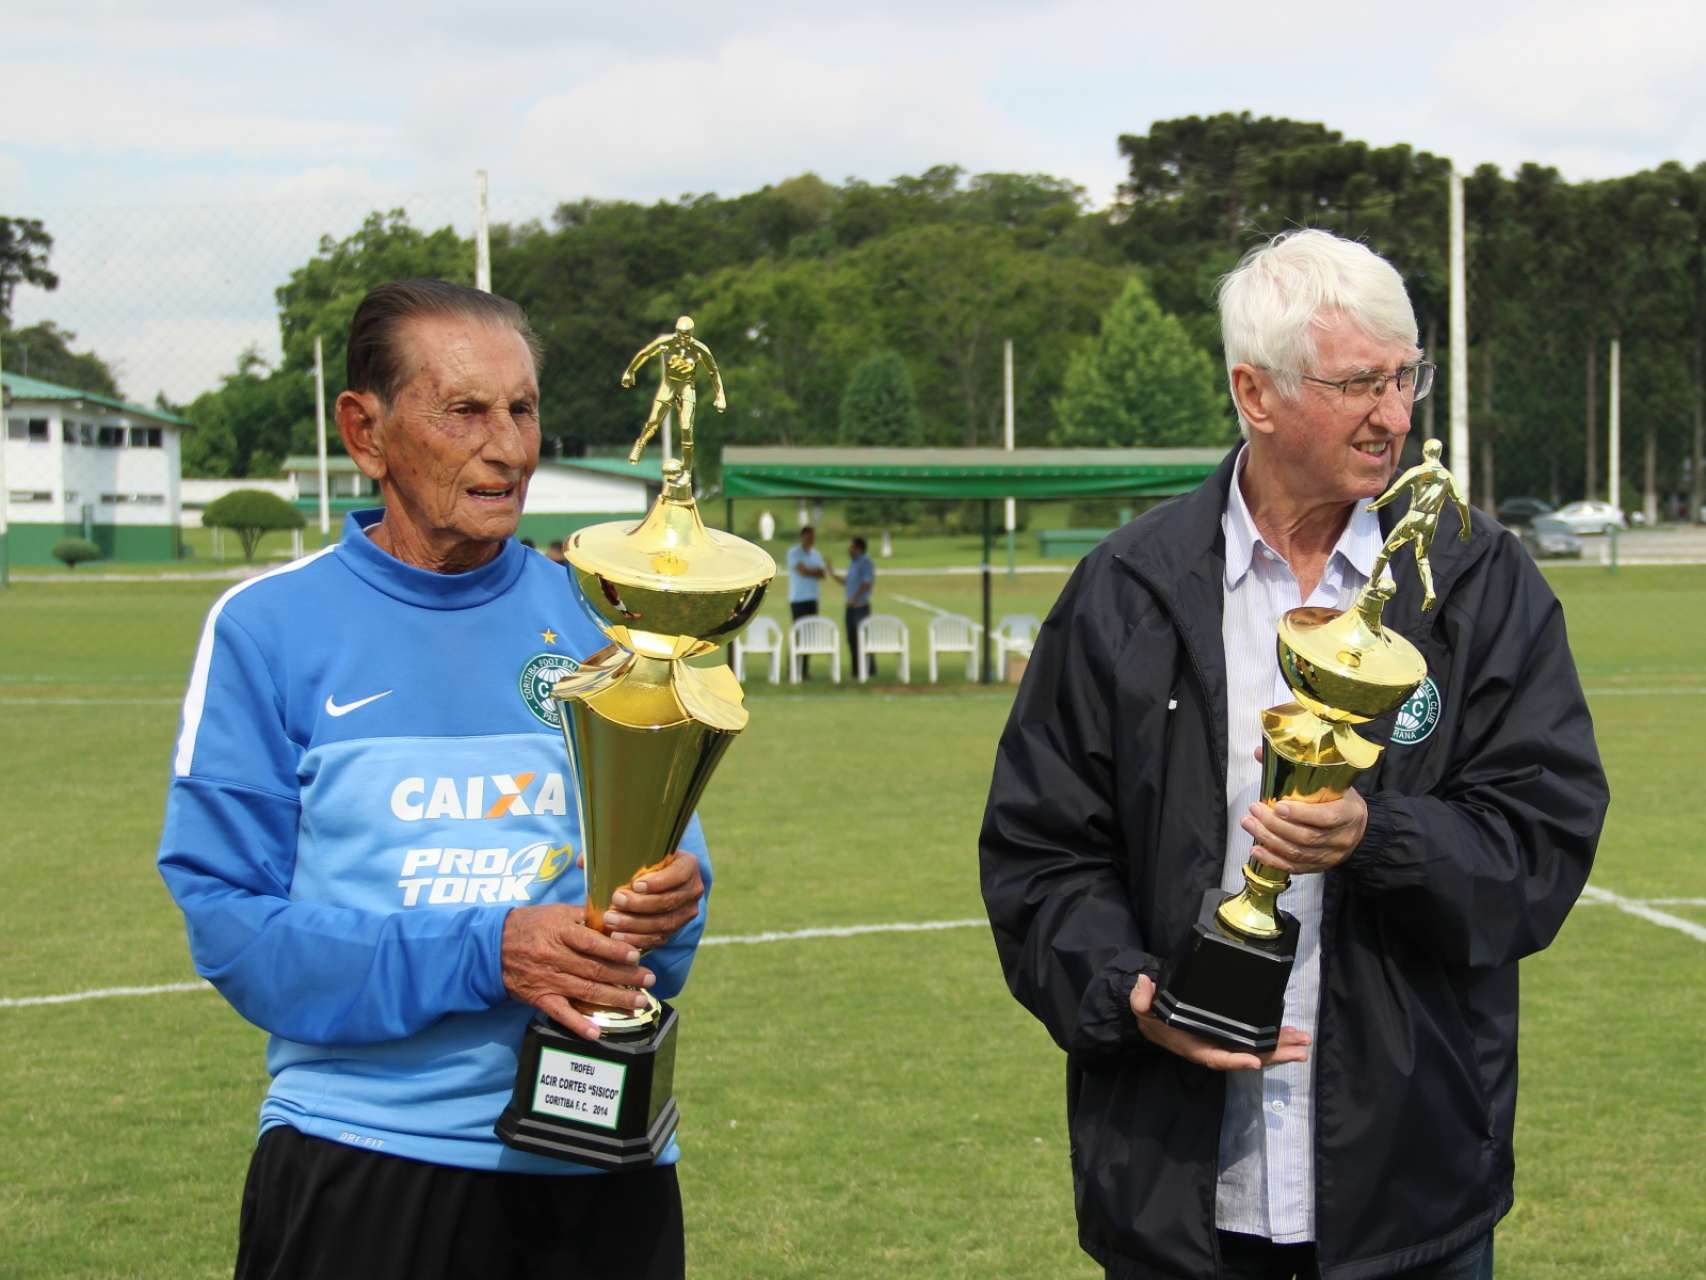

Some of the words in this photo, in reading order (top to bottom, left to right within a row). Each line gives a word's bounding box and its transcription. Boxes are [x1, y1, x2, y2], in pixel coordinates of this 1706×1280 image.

[561, 659, 578, 671] BAL
[1423, 684, 1435, 700] ALL
[1427, 701, 1438, 724] CLUB
[1393, 729, 1417, 739] RANA
[390, 772, 567, 821] CAIXA
[401, 848, 510, 877] PRO
[398, 874, 535, 907] TORK
[540, 1073, 558, 1087] ACIR
[559, 1078, 587, 1093] CORTES
[545, 1094, 574, 1109] CORITIBA
[593, 1104, 608, 1116] 2014
